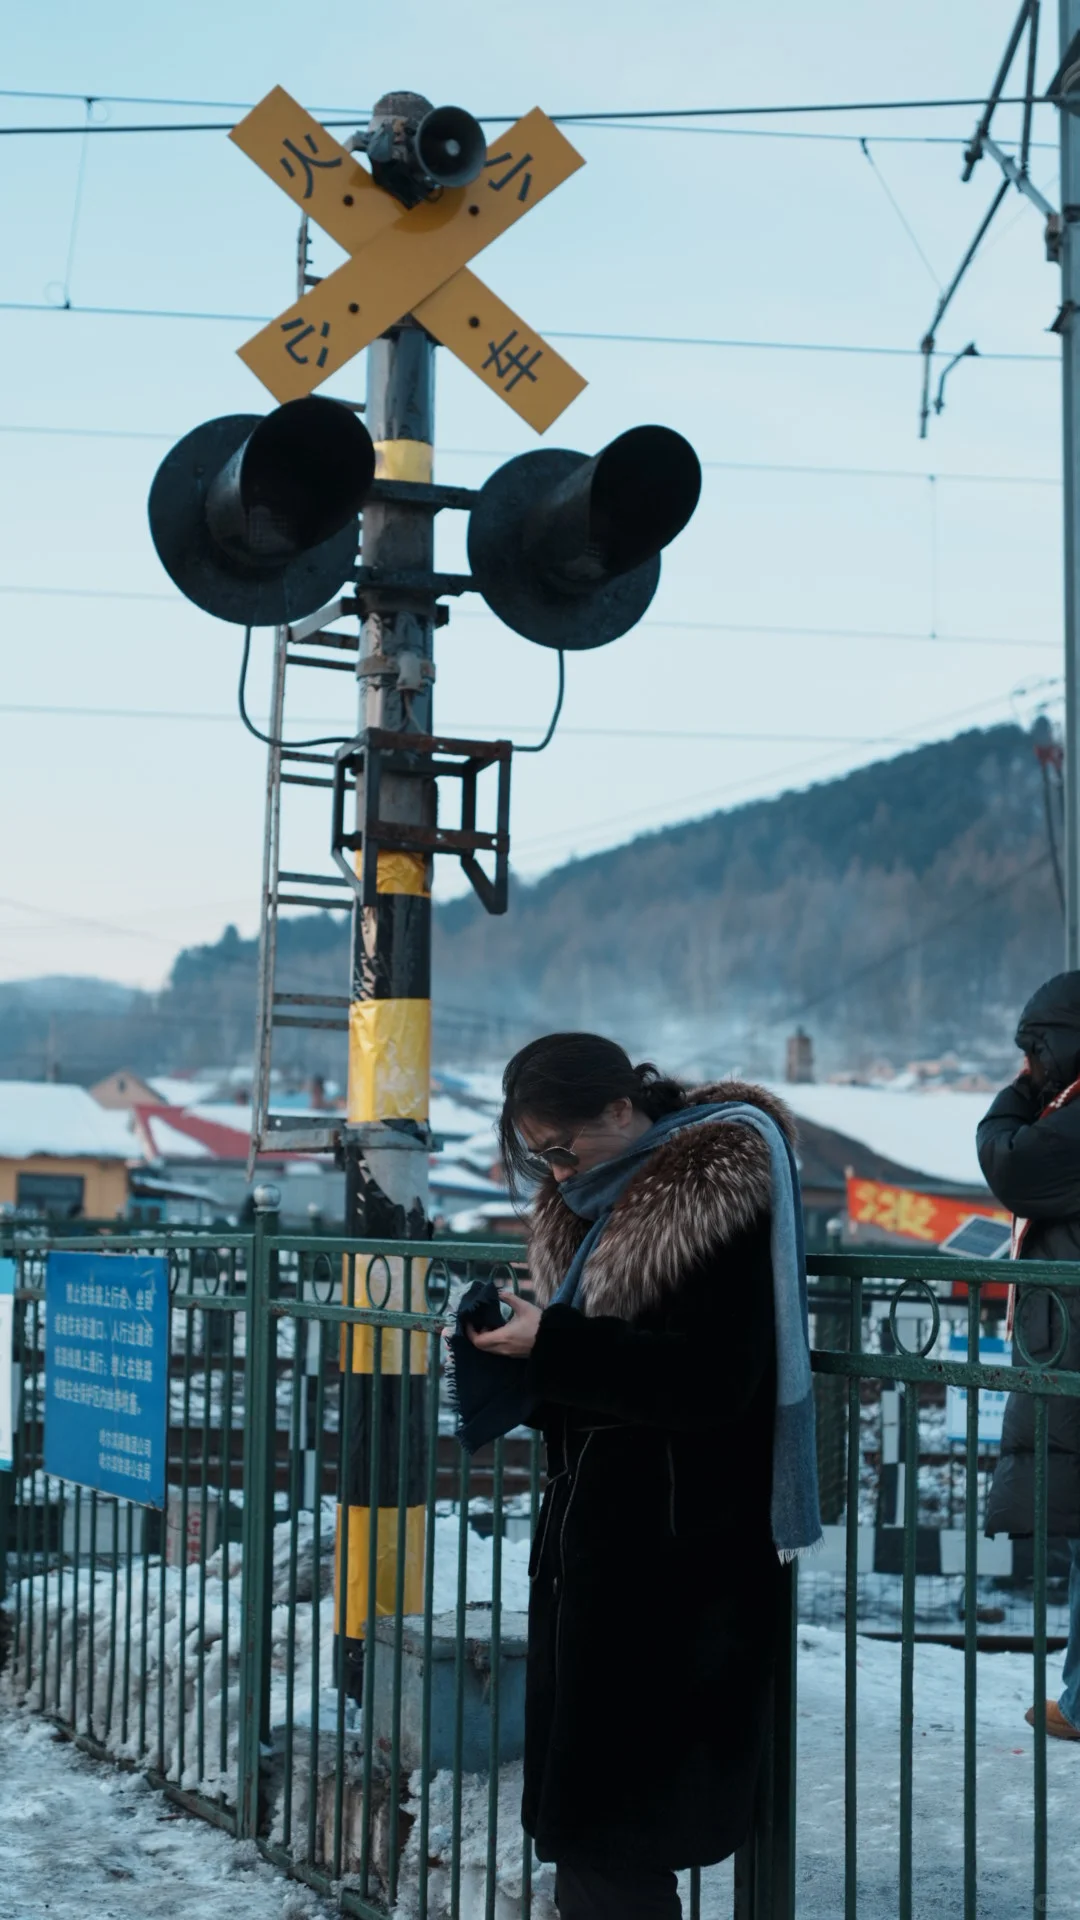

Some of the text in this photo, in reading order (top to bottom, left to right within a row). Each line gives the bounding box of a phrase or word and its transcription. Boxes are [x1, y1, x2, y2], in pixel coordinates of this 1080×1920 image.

[280, 133, 342, 199] 火
[484, 152, 533, 202] 小
[281, 317, 330, 368] 心
[481, 329, 543, 392] 车
